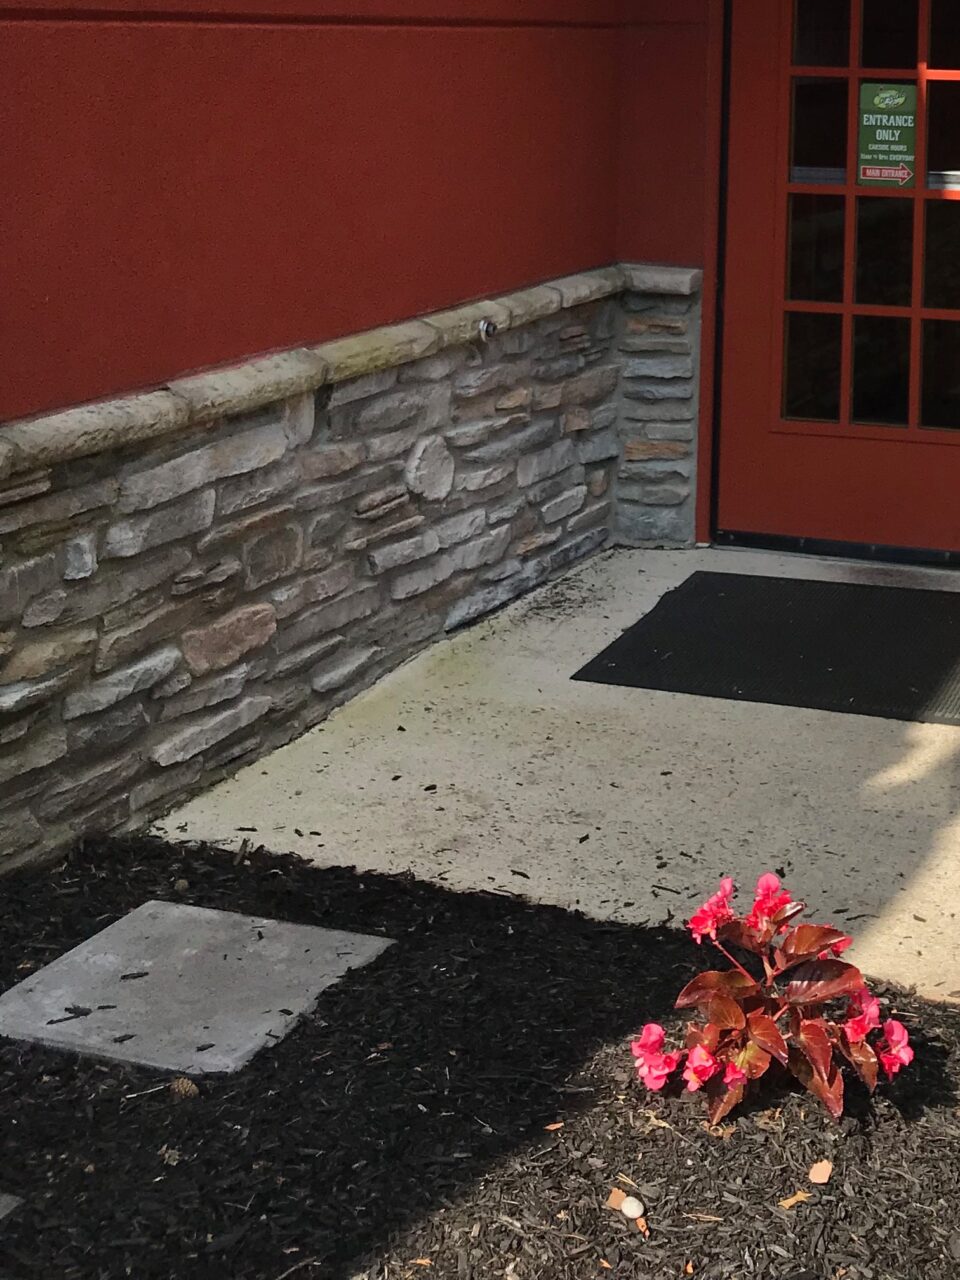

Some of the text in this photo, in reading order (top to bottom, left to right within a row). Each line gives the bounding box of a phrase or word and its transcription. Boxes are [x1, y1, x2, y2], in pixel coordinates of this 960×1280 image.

[863, 114, 914, 127] ENTRANCE
[876, 129, 901, 141] ONLY
[866, 168, 908, 178] MAIN ENTRANCE
